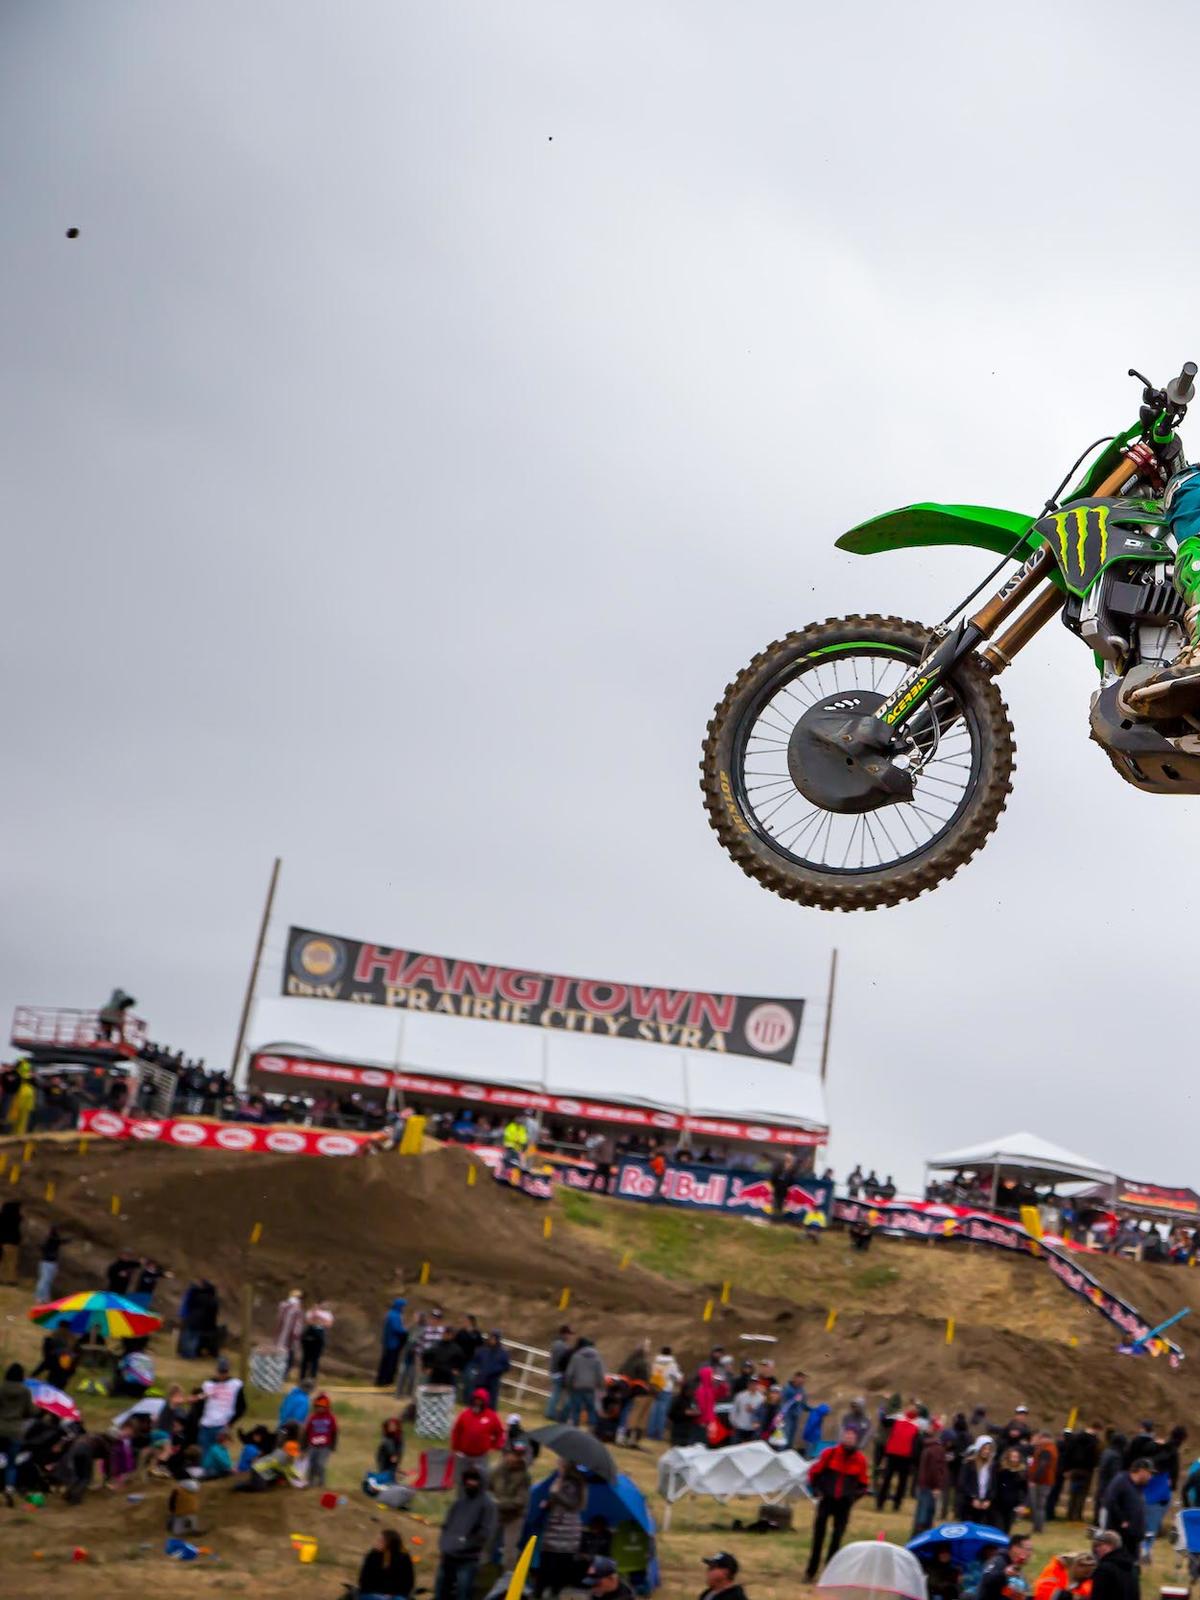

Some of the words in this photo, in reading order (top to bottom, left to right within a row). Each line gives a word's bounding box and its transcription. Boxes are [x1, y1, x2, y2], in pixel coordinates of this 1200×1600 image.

[874, 649, 938, 720] DUNLOP
[887, 677, 929, 726] ACERBIS
[353, 942, 738, 1033] HANGTOWN
[384, 986, 531, 1026] PRAIRIE
[539, 1007, 629, 1038] CITY
[637, 1019, 728, 1054] SVRA
[619, 1164, 676, 1199] Red
[674, 1169, 729, 1206] Bull
